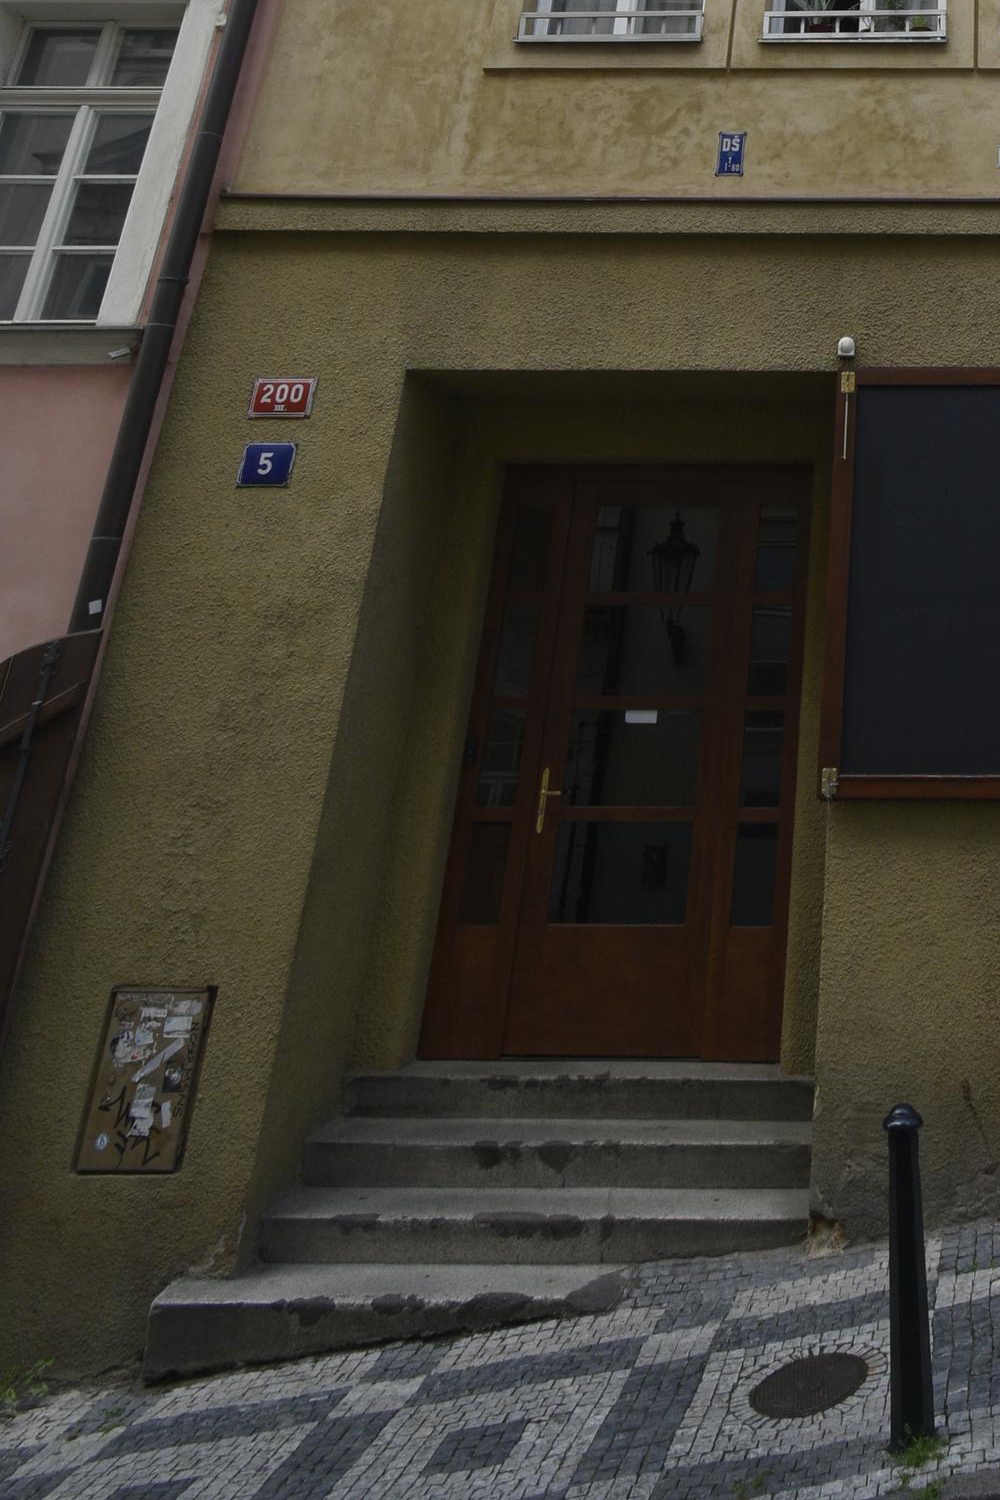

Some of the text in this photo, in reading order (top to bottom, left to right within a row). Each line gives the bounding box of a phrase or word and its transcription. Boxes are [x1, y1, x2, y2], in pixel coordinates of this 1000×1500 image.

[722, 135, 740, 152] DŠ
[260, 383, 304, 403] 200
[257, 452, 274, 475] 5
